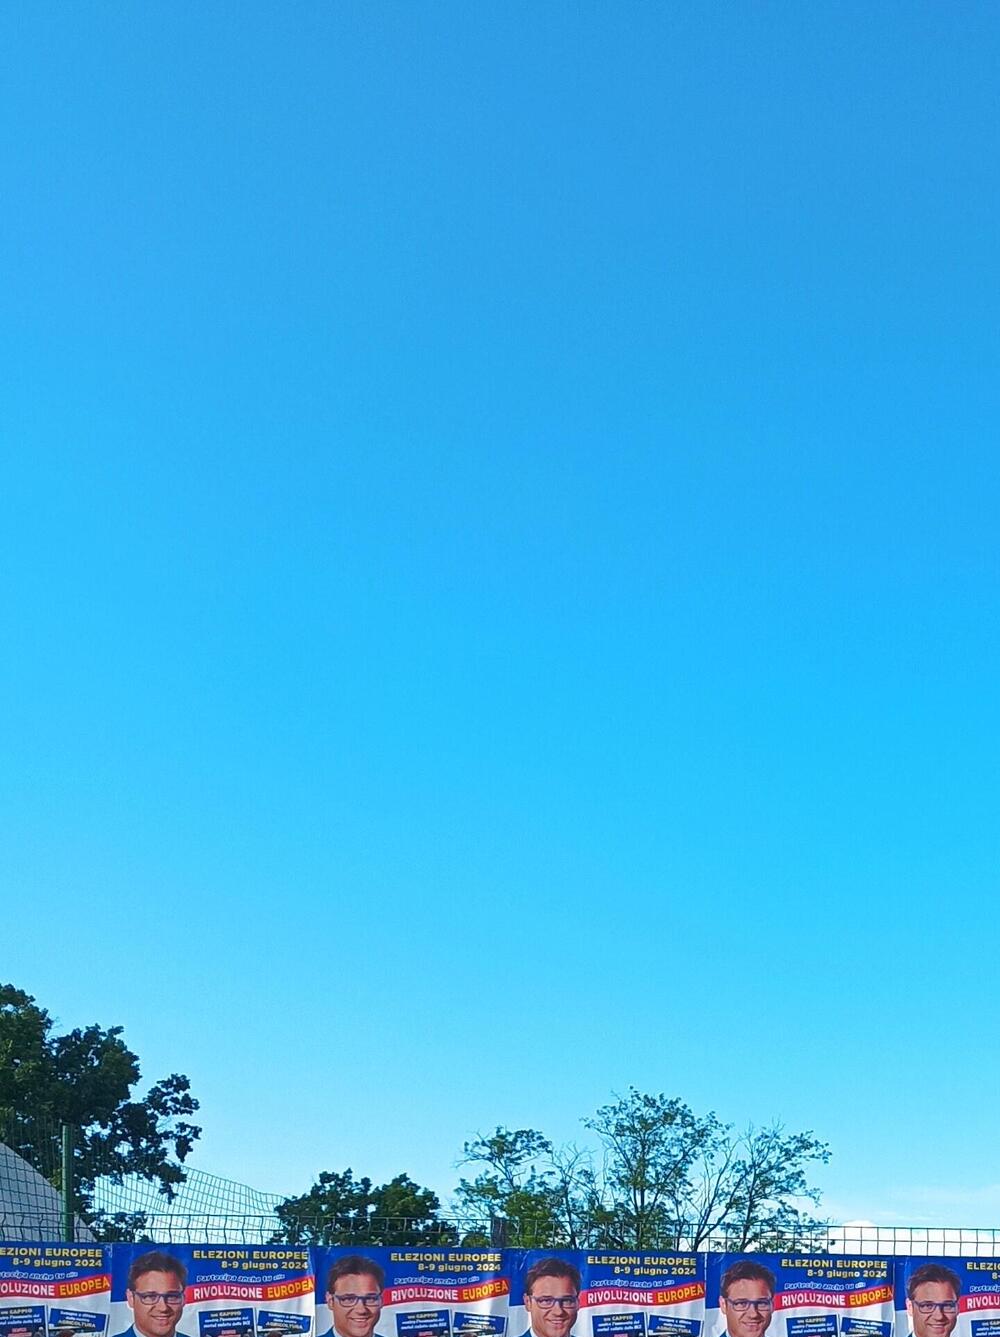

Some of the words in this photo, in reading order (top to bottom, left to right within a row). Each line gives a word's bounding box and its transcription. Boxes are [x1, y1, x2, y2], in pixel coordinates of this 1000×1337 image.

[45, 1248, 103, 1257] EUROPEE
[194, 1250, 249, 1259] ELEZIONI
[253, 1251, 308, 1260] EUROPEE
[391, 1253, 444, 1261] ELEZIONI
[449, 1253, 502, 1262] EUROPEE
[588, 1256, 640, 1264] ELEZIONI
[644, 1257, 697, 1265] EUROPEE
[13, 1258, 30, 1266] 8-9
[34, 1258, 71, 1267] giugno
[75, 1259, 102, 1267] 2024
[242, 1261, 278, 1270] giugno
[782, 1259, 833, 1268] ELEZIONI
[837, 1260, 888, 1268] EUROPEE
[438, 1263, 473, 1272] giugno
[634, 1267, 668, 1275] giugno
[826, 1270, 860, 1278] giugno
[0, 1283, 55, 1297] OLUZIONE
[60, 1276, 110, 1296] EUROPEA
[194, 1286, 262, 1299] RIVOLUZIONE
[267, 1278, 314, 1298] EUROPEA
[391, 1288, 458, 1301] RIVOLUZIONE
[463, 1280, 508, 1300] EUROPEA
[588, 1290, 653, 1304] RIVOLUZIONE
[658, 1283, 703, 1303] EUROPEA
[782, 1293, 845, 1306] RIVOLUZIONE
[850, 1287, 892, 1305] EUROPEA
